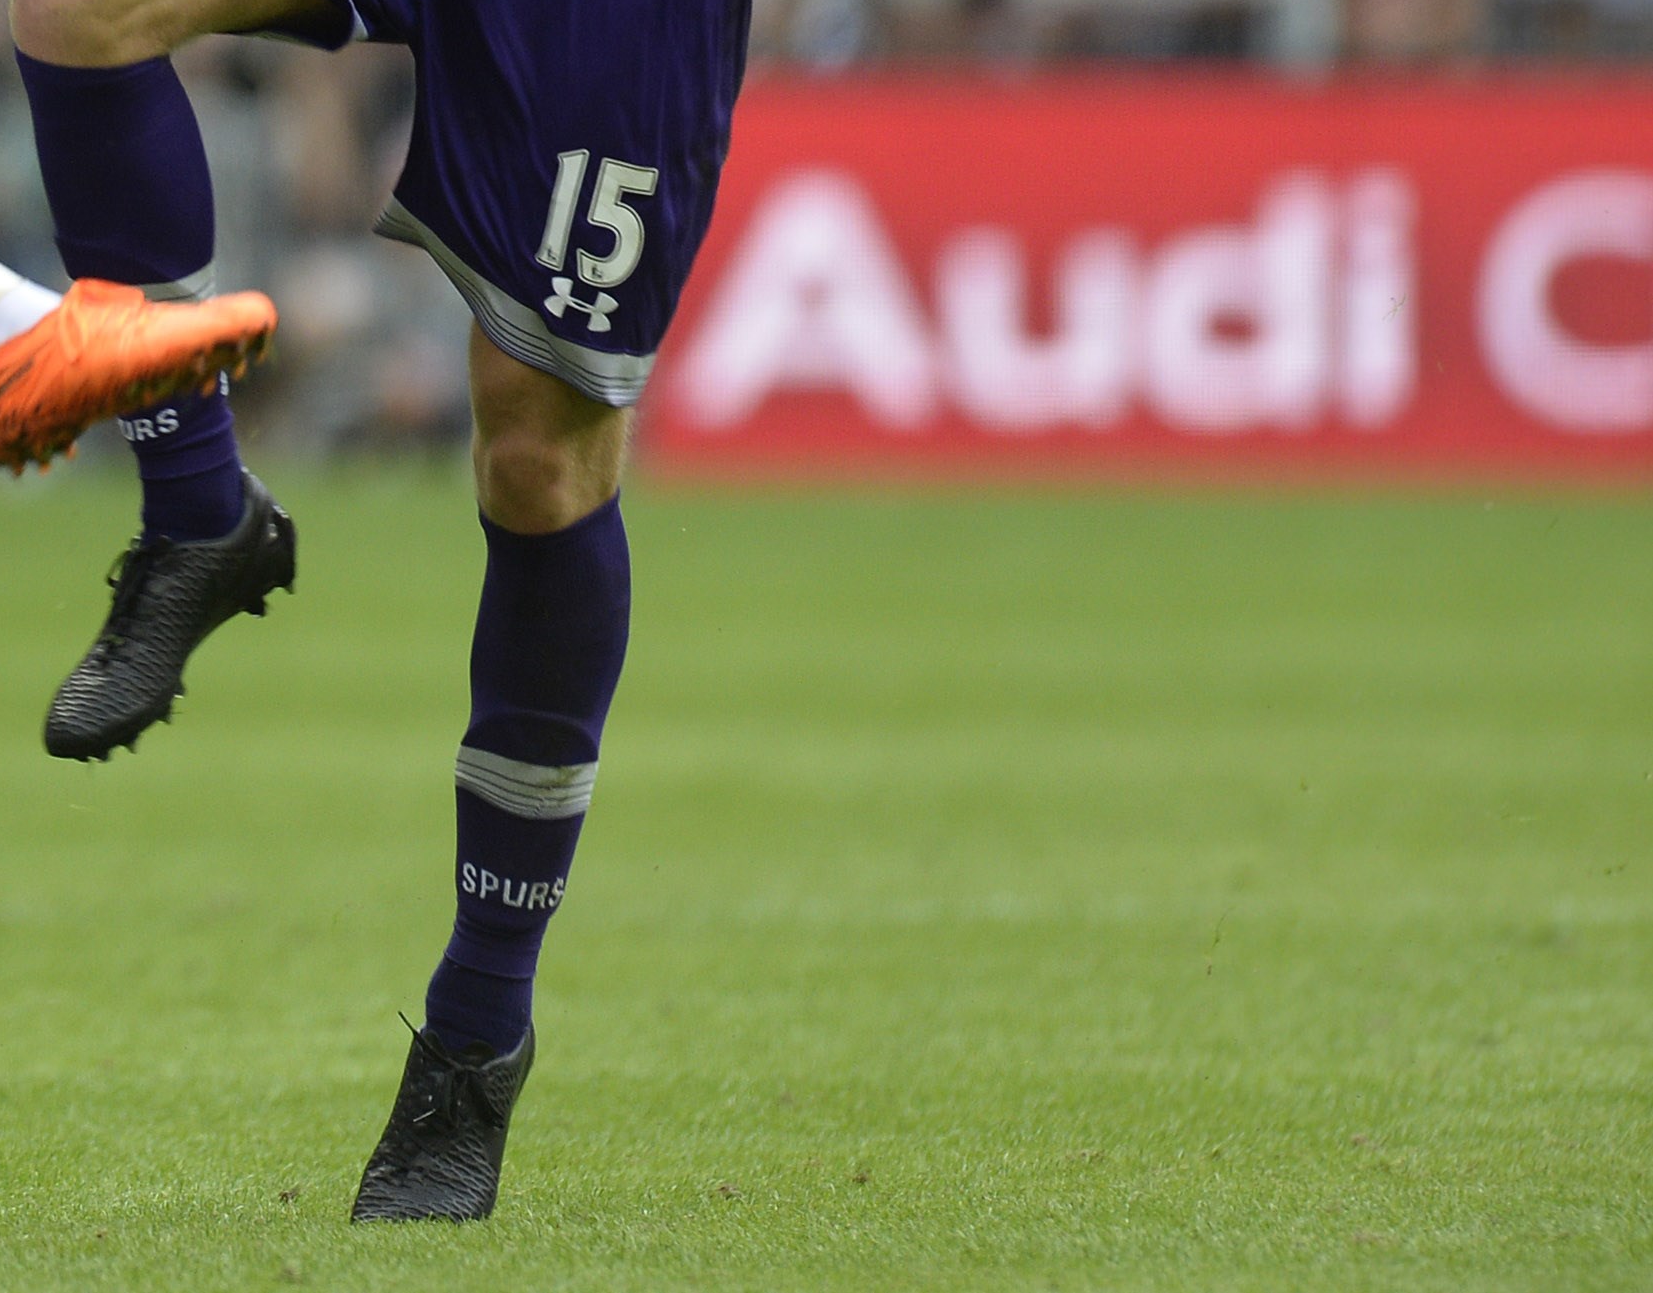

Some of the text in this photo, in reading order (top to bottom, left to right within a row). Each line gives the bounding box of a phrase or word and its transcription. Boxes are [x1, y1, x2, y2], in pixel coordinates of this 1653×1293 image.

[535, 148, 659, 288] 15
[674, 163, 1418, 434] Audi
[462, 862, 564, 910] SPURS
